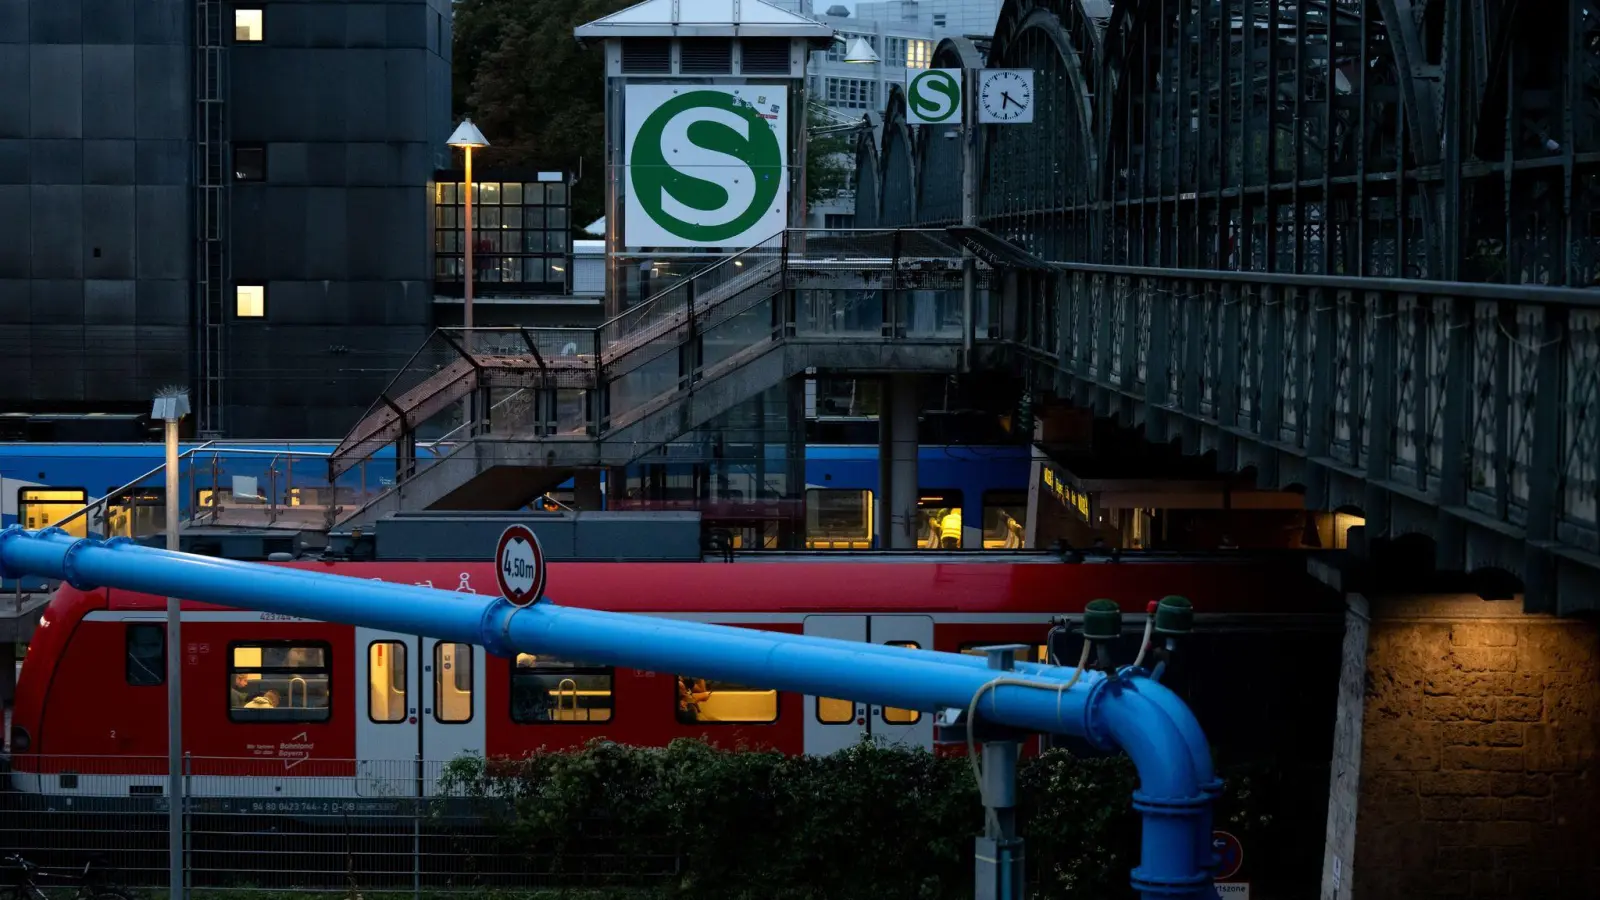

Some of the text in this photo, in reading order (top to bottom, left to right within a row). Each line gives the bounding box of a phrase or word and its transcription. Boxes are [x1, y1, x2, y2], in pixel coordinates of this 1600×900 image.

[916, 74, 952, 119] S
[660, 106, 757, 227] S
[503, 549, 534, 579] 4,50m
[109, 729, 117, 739] 2
